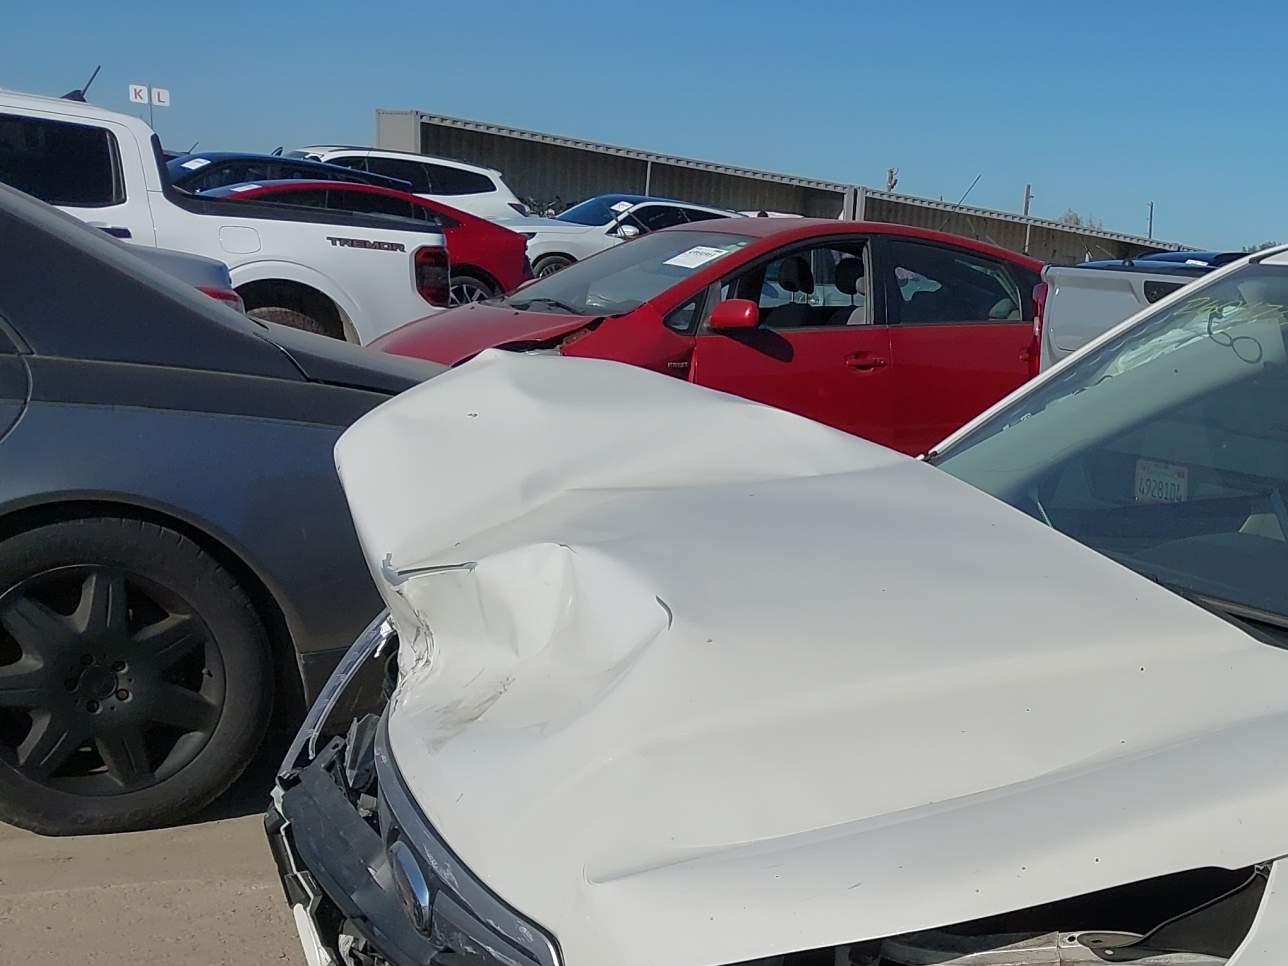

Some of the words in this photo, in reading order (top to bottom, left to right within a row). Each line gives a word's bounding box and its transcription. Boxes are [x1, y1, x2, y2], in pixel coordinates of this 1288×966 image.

[134, 88, 144, 100] K
[157, 91, 166, 104] L
[326, 236, 407, 253] TREMOR
